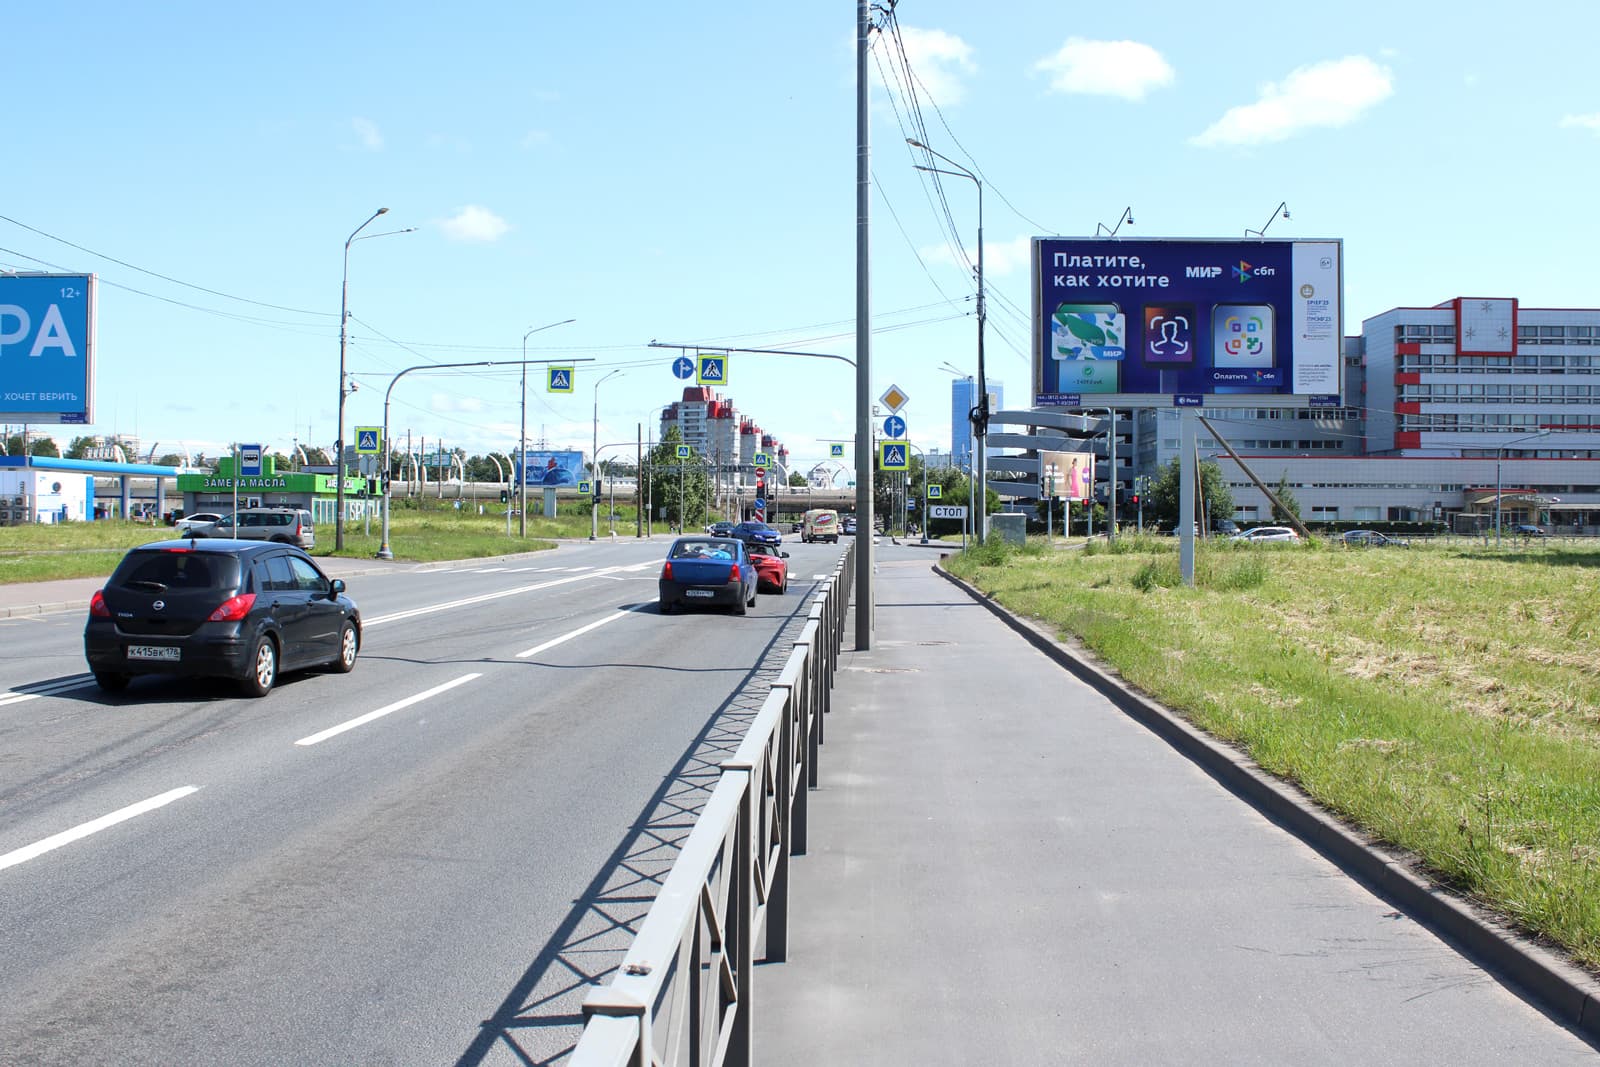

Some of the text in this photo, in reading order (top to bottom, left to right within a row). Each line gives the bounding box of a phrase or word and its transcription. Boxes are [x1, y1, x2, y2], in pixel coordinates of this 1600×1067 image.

[1054, 252, 1145, 270] Платите,
[1185, 266, 1223, 278] МИР
[1253, 266, 1275, 276] сбп
[1054, 275, 1169, 287] как хотите
[60, 287, 81, 298] 12+
[1213, 372, 1248, 380] Оплатить
[4, 392, 78, 401] ХОЧЕТ ВЕРИТЬ
[204, 478, 286, 488] ЗАМЕНА МАСЛА
[935, 507, 962, 517] СТОП
